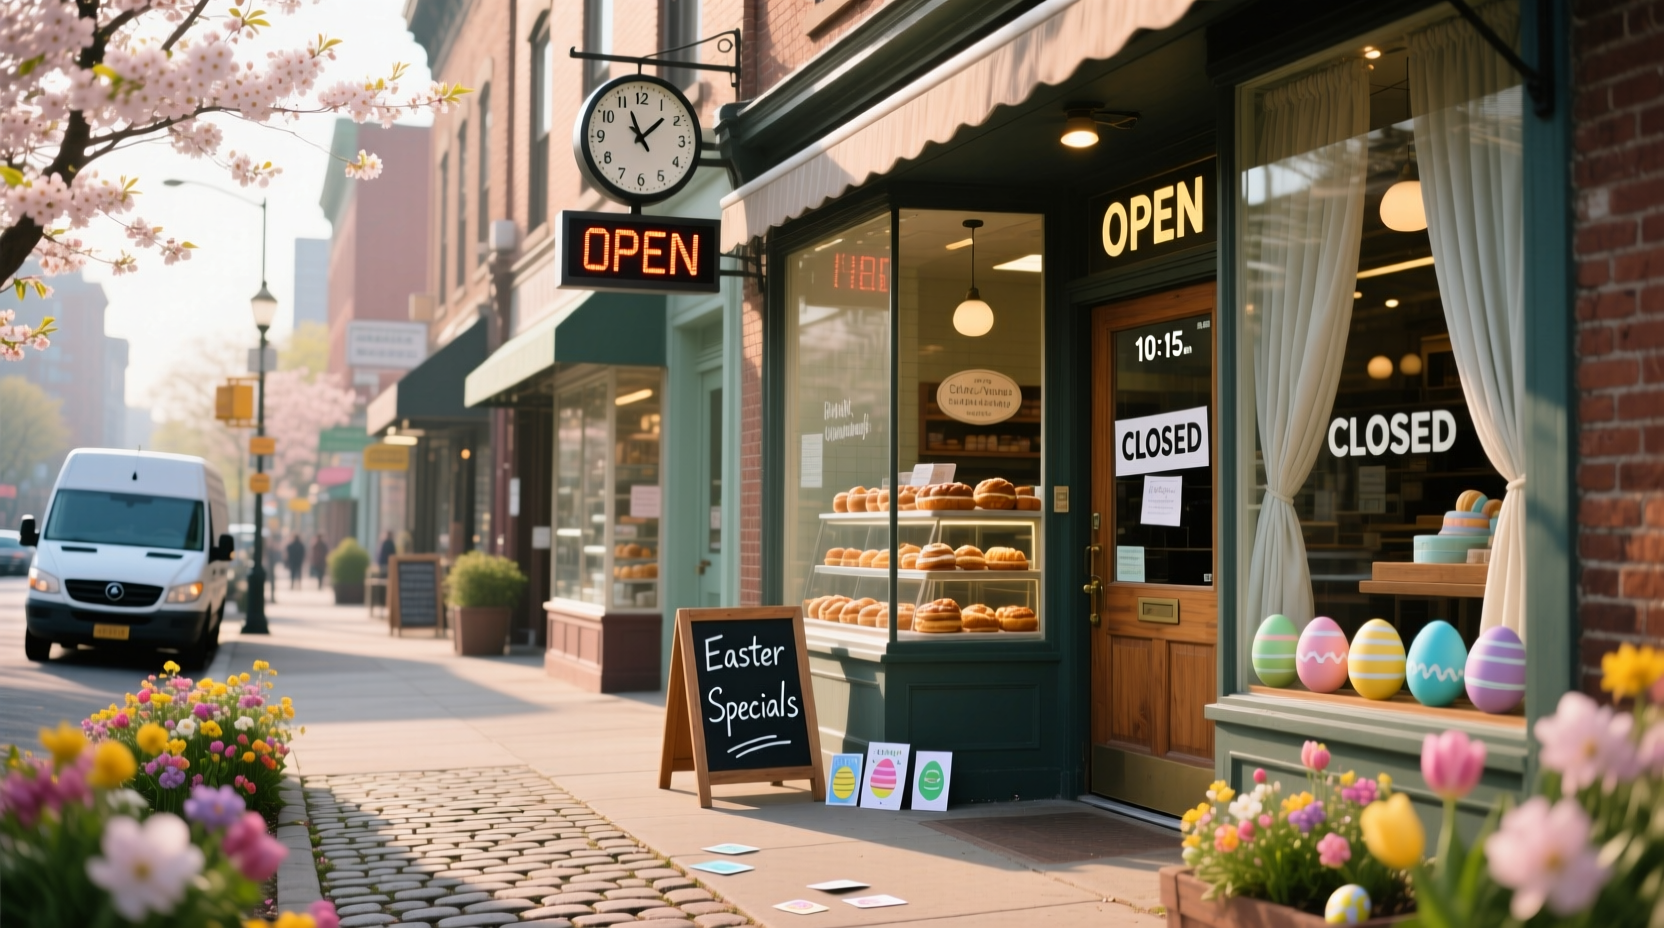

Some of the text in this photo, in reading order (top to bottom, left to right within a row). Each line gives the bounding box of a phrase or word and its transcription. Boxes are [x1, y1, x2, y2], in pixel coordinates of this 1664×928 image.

[618, 96, 627, 109] 11
[636, 92, 649, 105] 12
[602, 110, 615, 123] 10
[673, 115, 682, 127] 2
[596, 129, 606, 143] 9
[678, 135, 686, 148] 3
[604, 151, 612, 164] 8
[672, 156, 680, 168] 4
[618, 167, 626, 180] 7
[637, 173, 645, 186] 6
[1102, 175, 1203, 257] OPEN
[583, 227, 699, 276] OPEN
[1328, 409, 1457, 458] CLOSED
[1122, 422, 1202, 461] CLOSED
[705, 634, 785, 672] Easter
[708, 680, 799, 737] Specials
